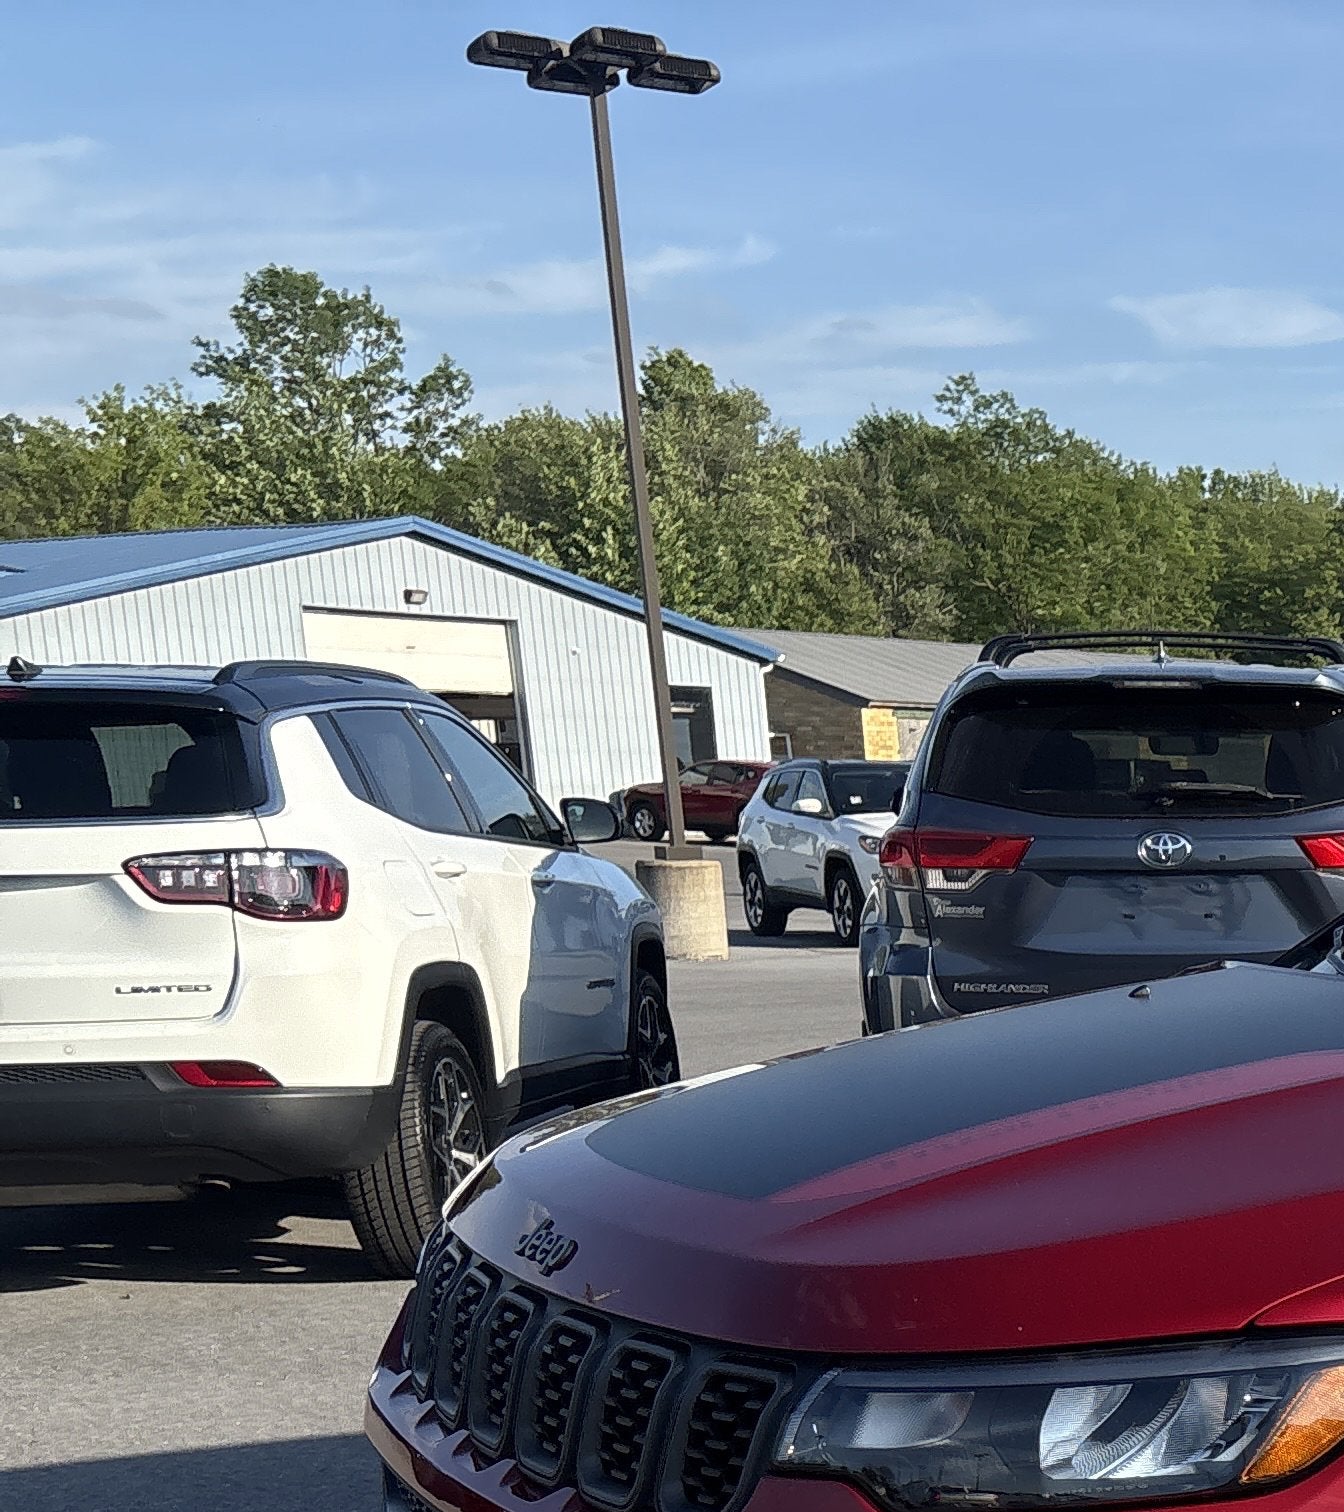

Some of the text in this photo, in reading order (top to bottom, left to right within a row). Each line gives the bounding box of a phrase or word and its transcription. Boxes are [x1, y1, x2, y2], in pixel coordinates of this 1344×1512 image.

[934, 904, 986, 918] Alexander
[115, 984, 212, 995] LIMITED
[953, 982, 1049, 995] HIGHLANDER
[514, 1218, 579, 1278] Jeep
